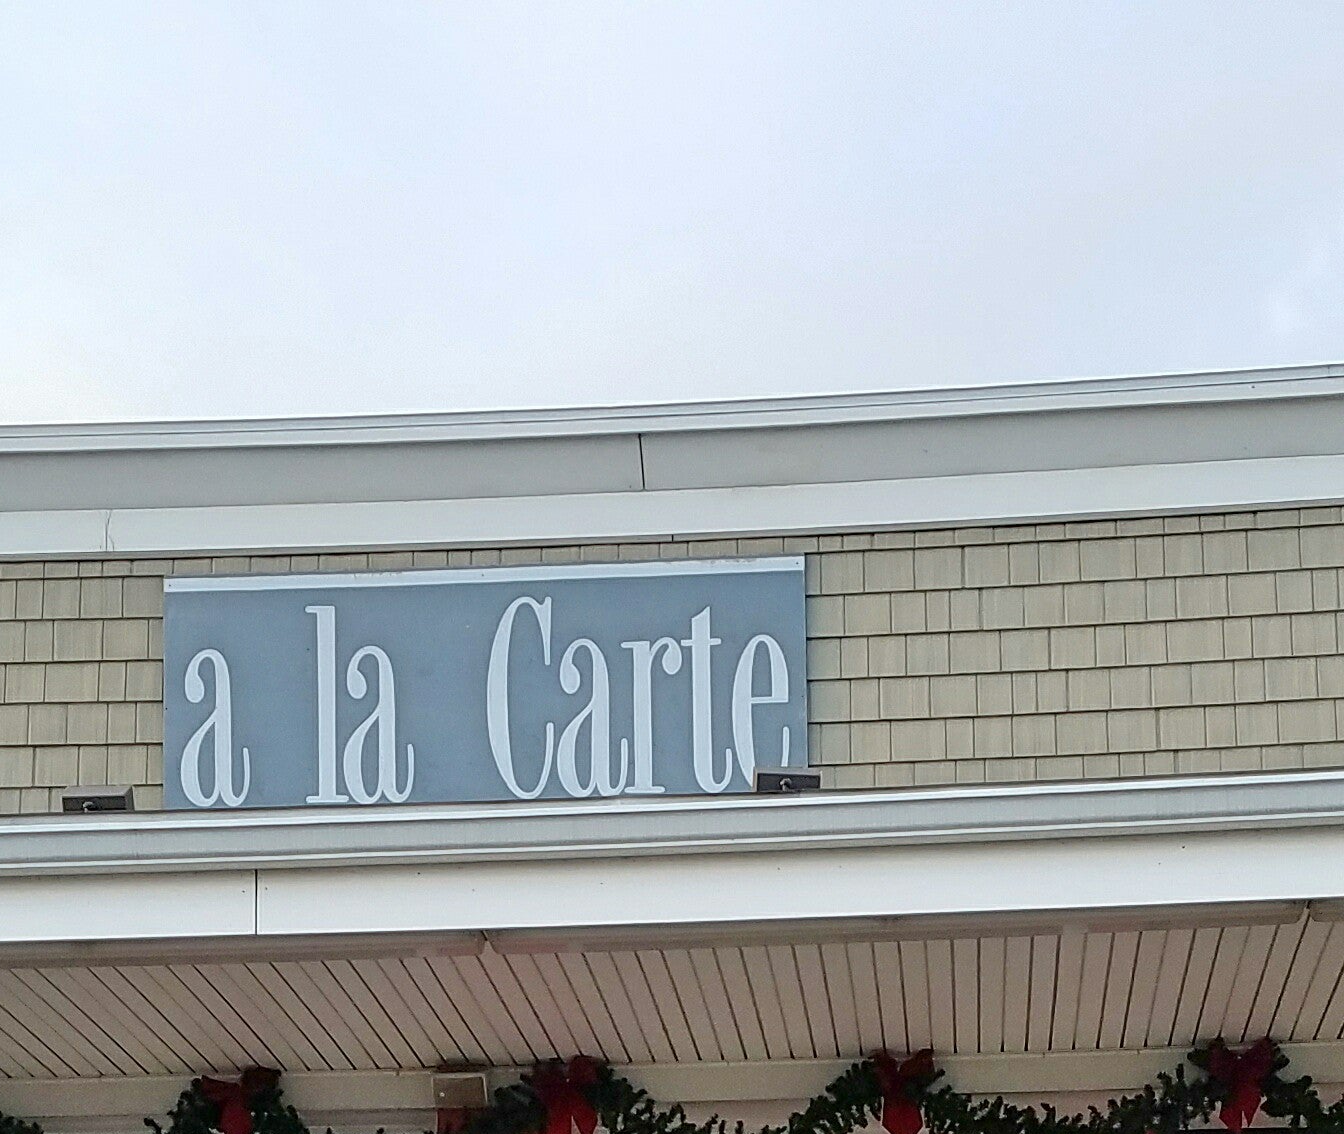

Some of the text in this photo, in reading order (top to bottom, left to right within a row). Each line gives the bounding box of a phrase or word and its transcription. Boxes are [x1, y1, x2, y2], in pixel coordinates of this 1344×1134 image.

[180, 596, 790, 808] a la Carte
